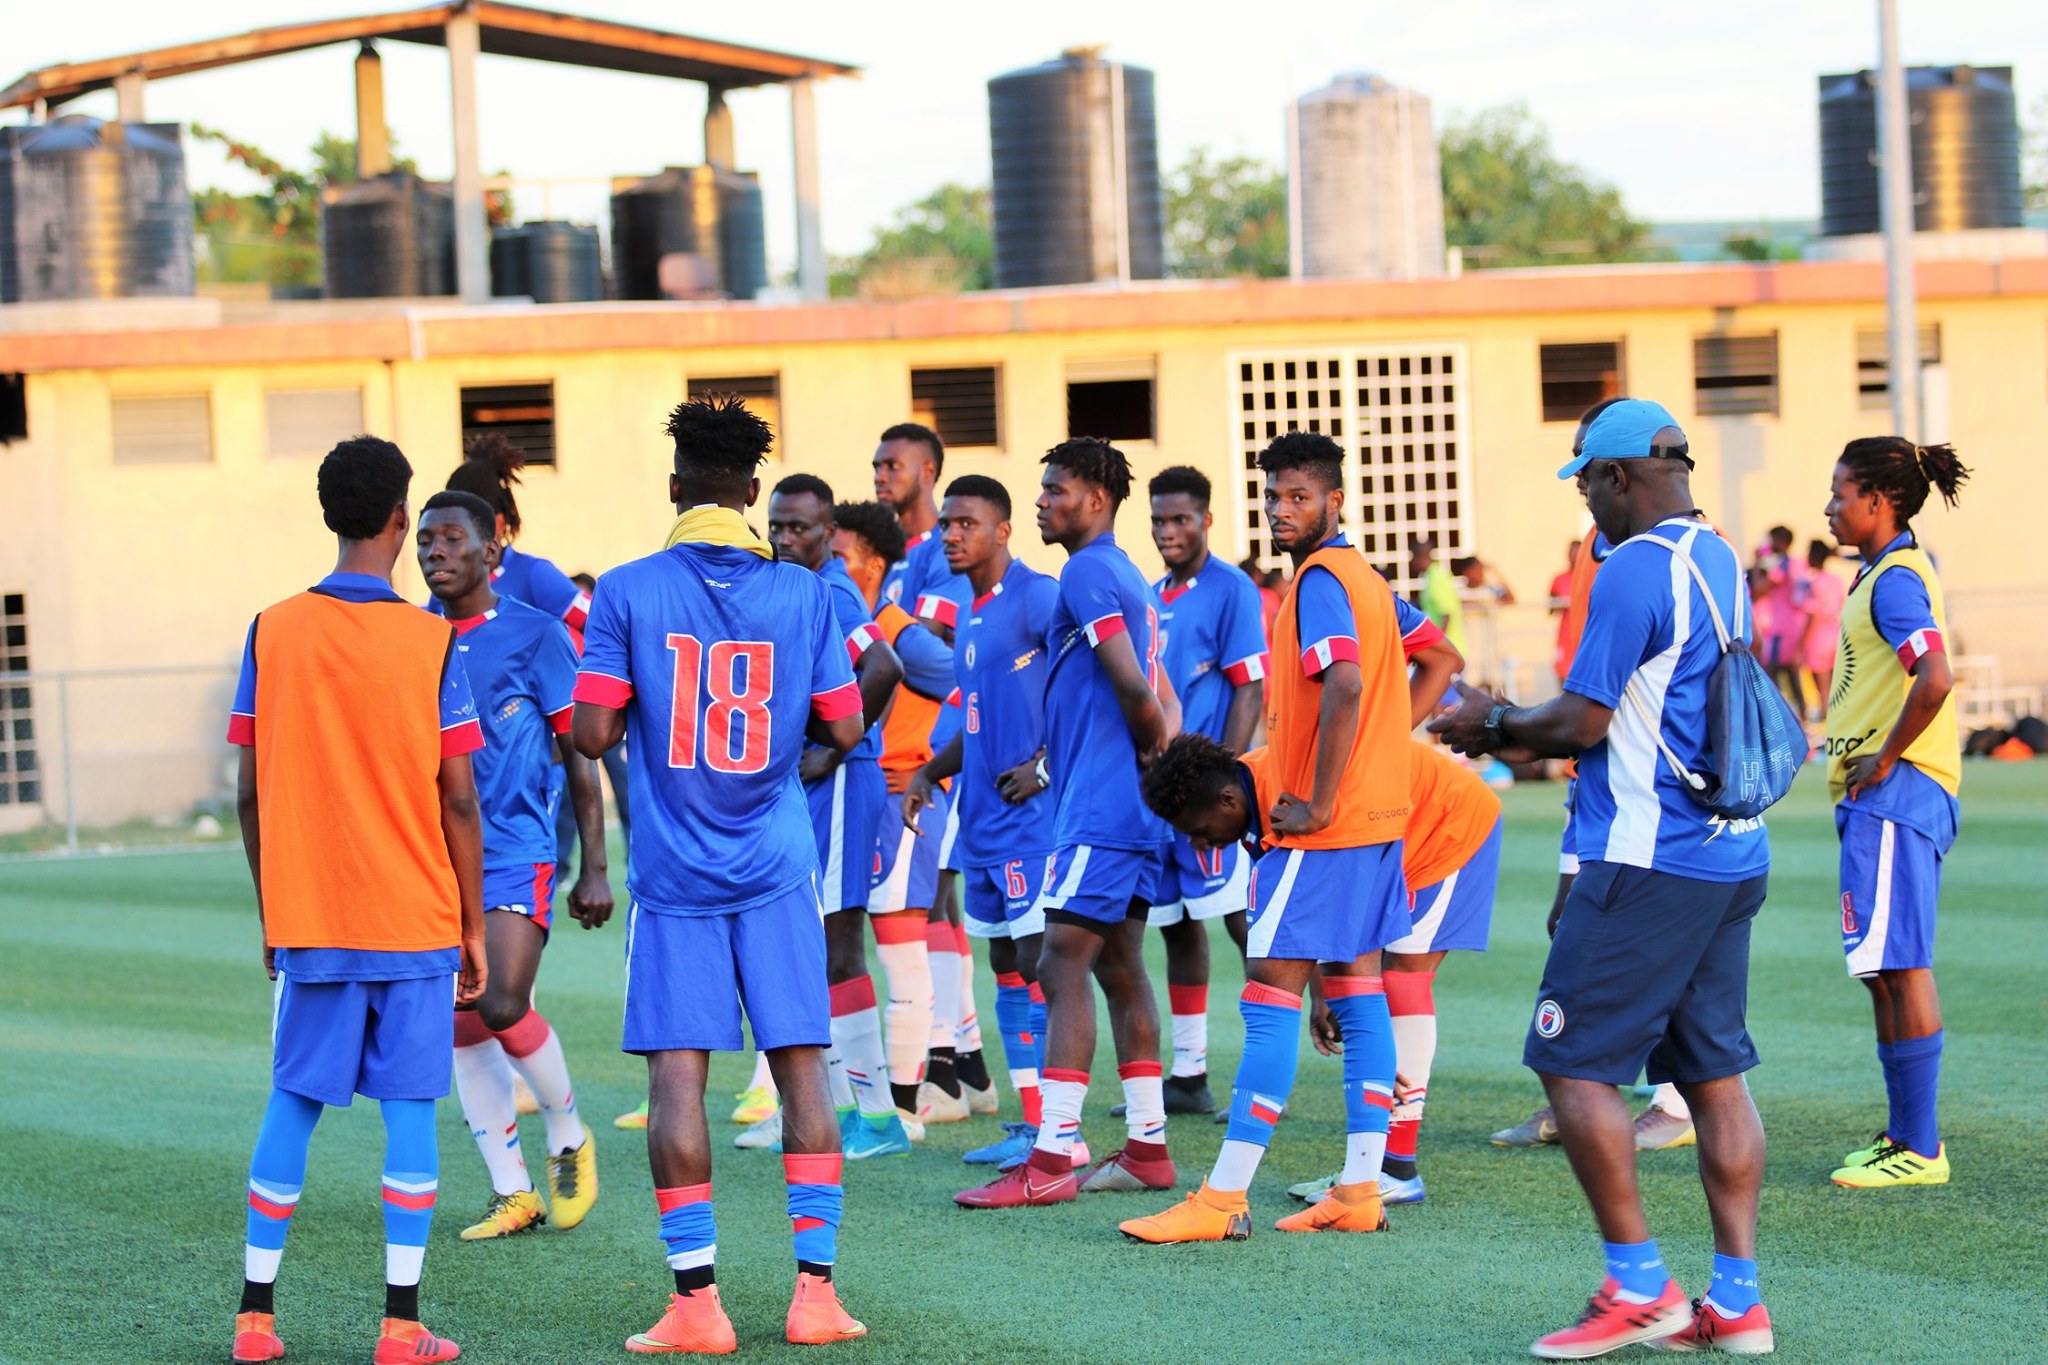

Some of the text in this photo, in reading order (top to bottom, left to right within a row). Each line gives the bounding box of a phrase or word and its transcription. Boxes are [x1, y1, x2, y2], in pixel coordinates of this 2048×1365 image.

[666, 633, 775, 774] 18
[966, 692, 980, 734] 6
[1005, 858, 1028, 899] 6
